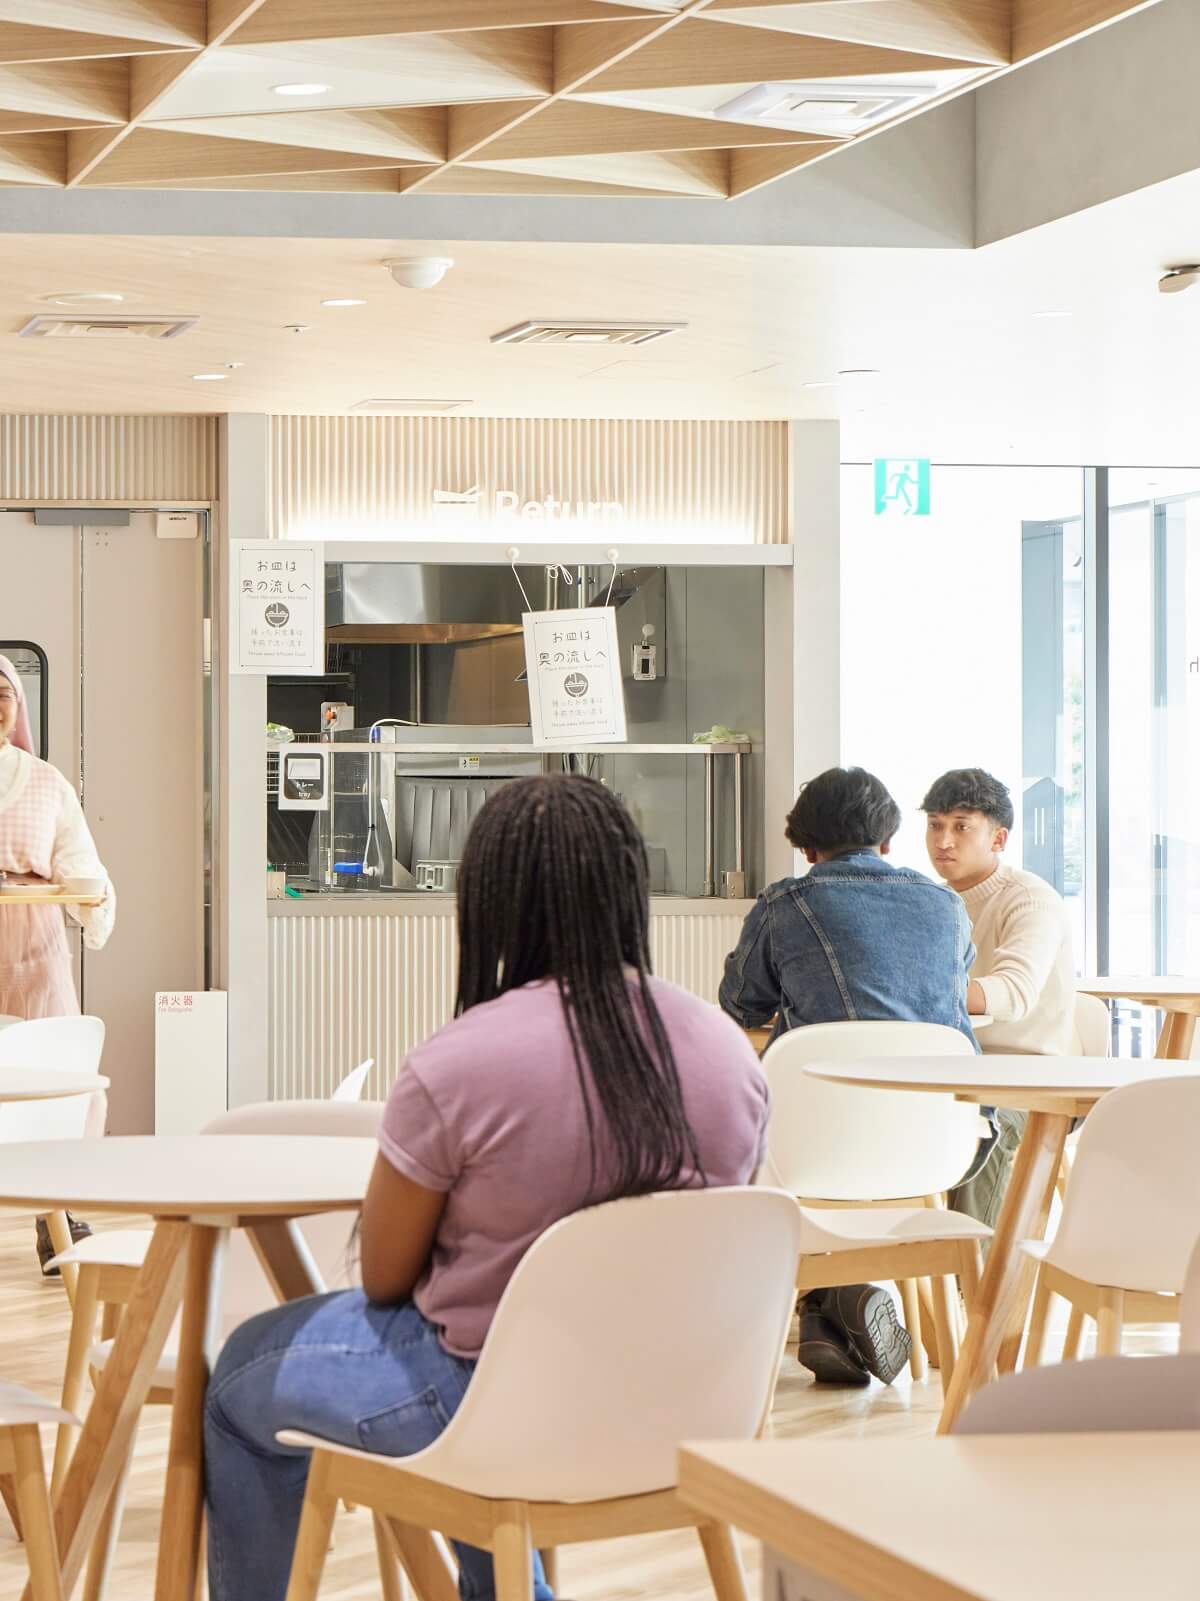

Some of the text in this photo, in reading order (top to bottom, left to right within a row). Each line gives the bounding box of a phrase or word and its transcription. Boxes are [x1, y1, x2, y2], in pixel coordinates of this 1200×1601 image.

[496, 490, 624, 522] Return
[257, 560, 297, 572] お皿は
[242, 579, 312, 593] 奥の流しへ
[552, 630, 591, 643] お皿は
[539, 650, 607, 666] 奥の流しへ
[296, 781, 314, 789] トレー
[159, 994, 193, 1006] 消火器
